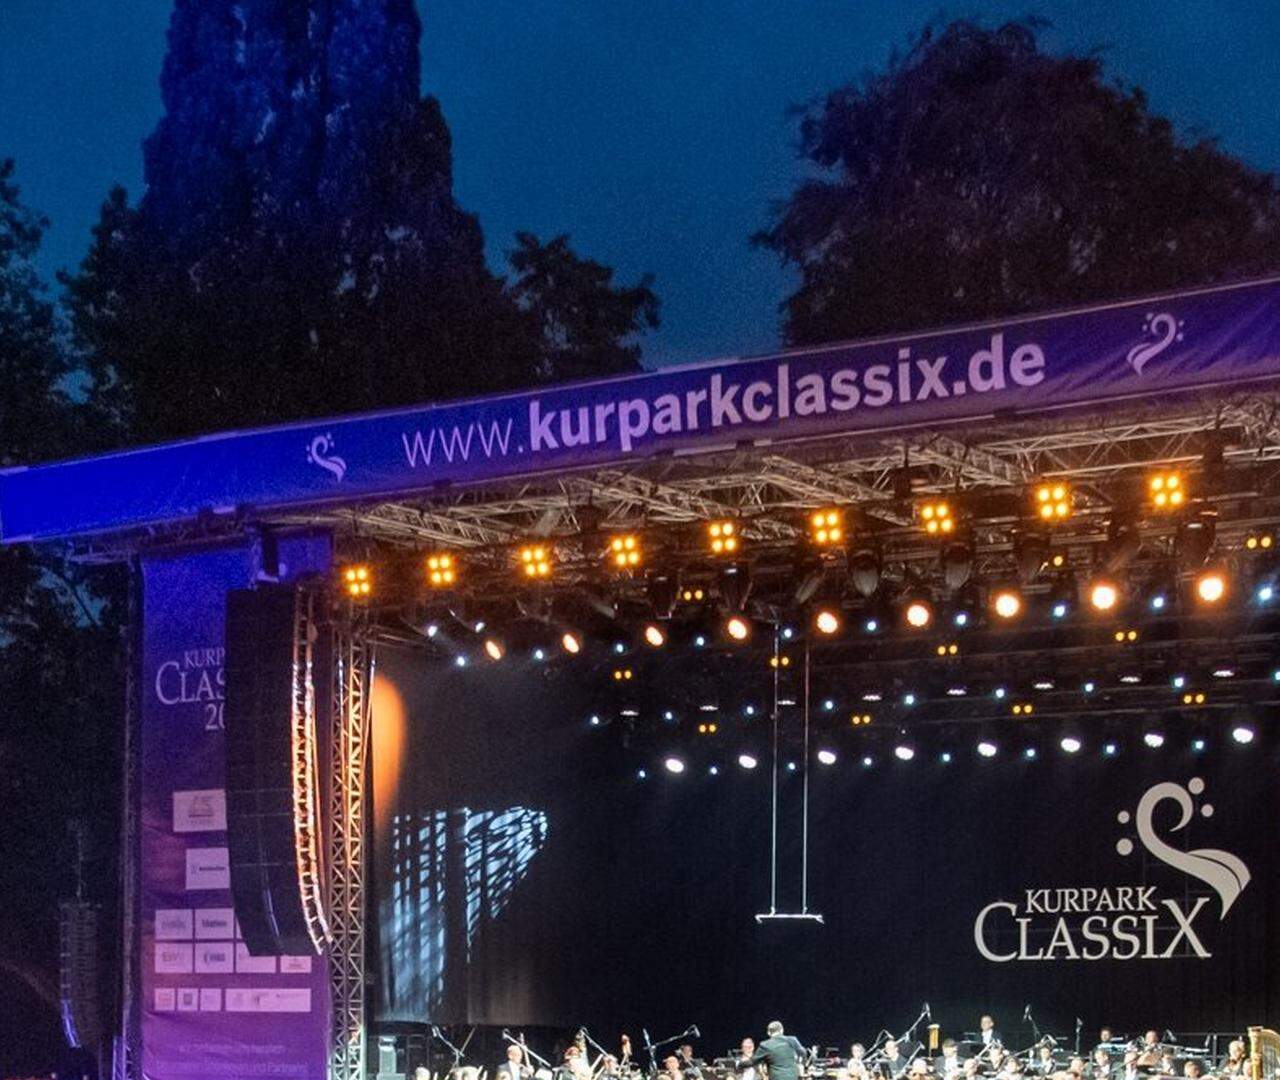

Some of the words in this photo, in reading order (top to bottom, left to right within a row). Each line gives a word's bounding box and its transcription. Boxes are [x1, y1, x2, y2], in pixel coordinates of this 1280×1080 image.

[402, 332, 1046, 468] www.kurparkclassix.de
[973, 896, 1213, 963] CLASSIX
[1025, 886, 1158, 914] KURPARK
